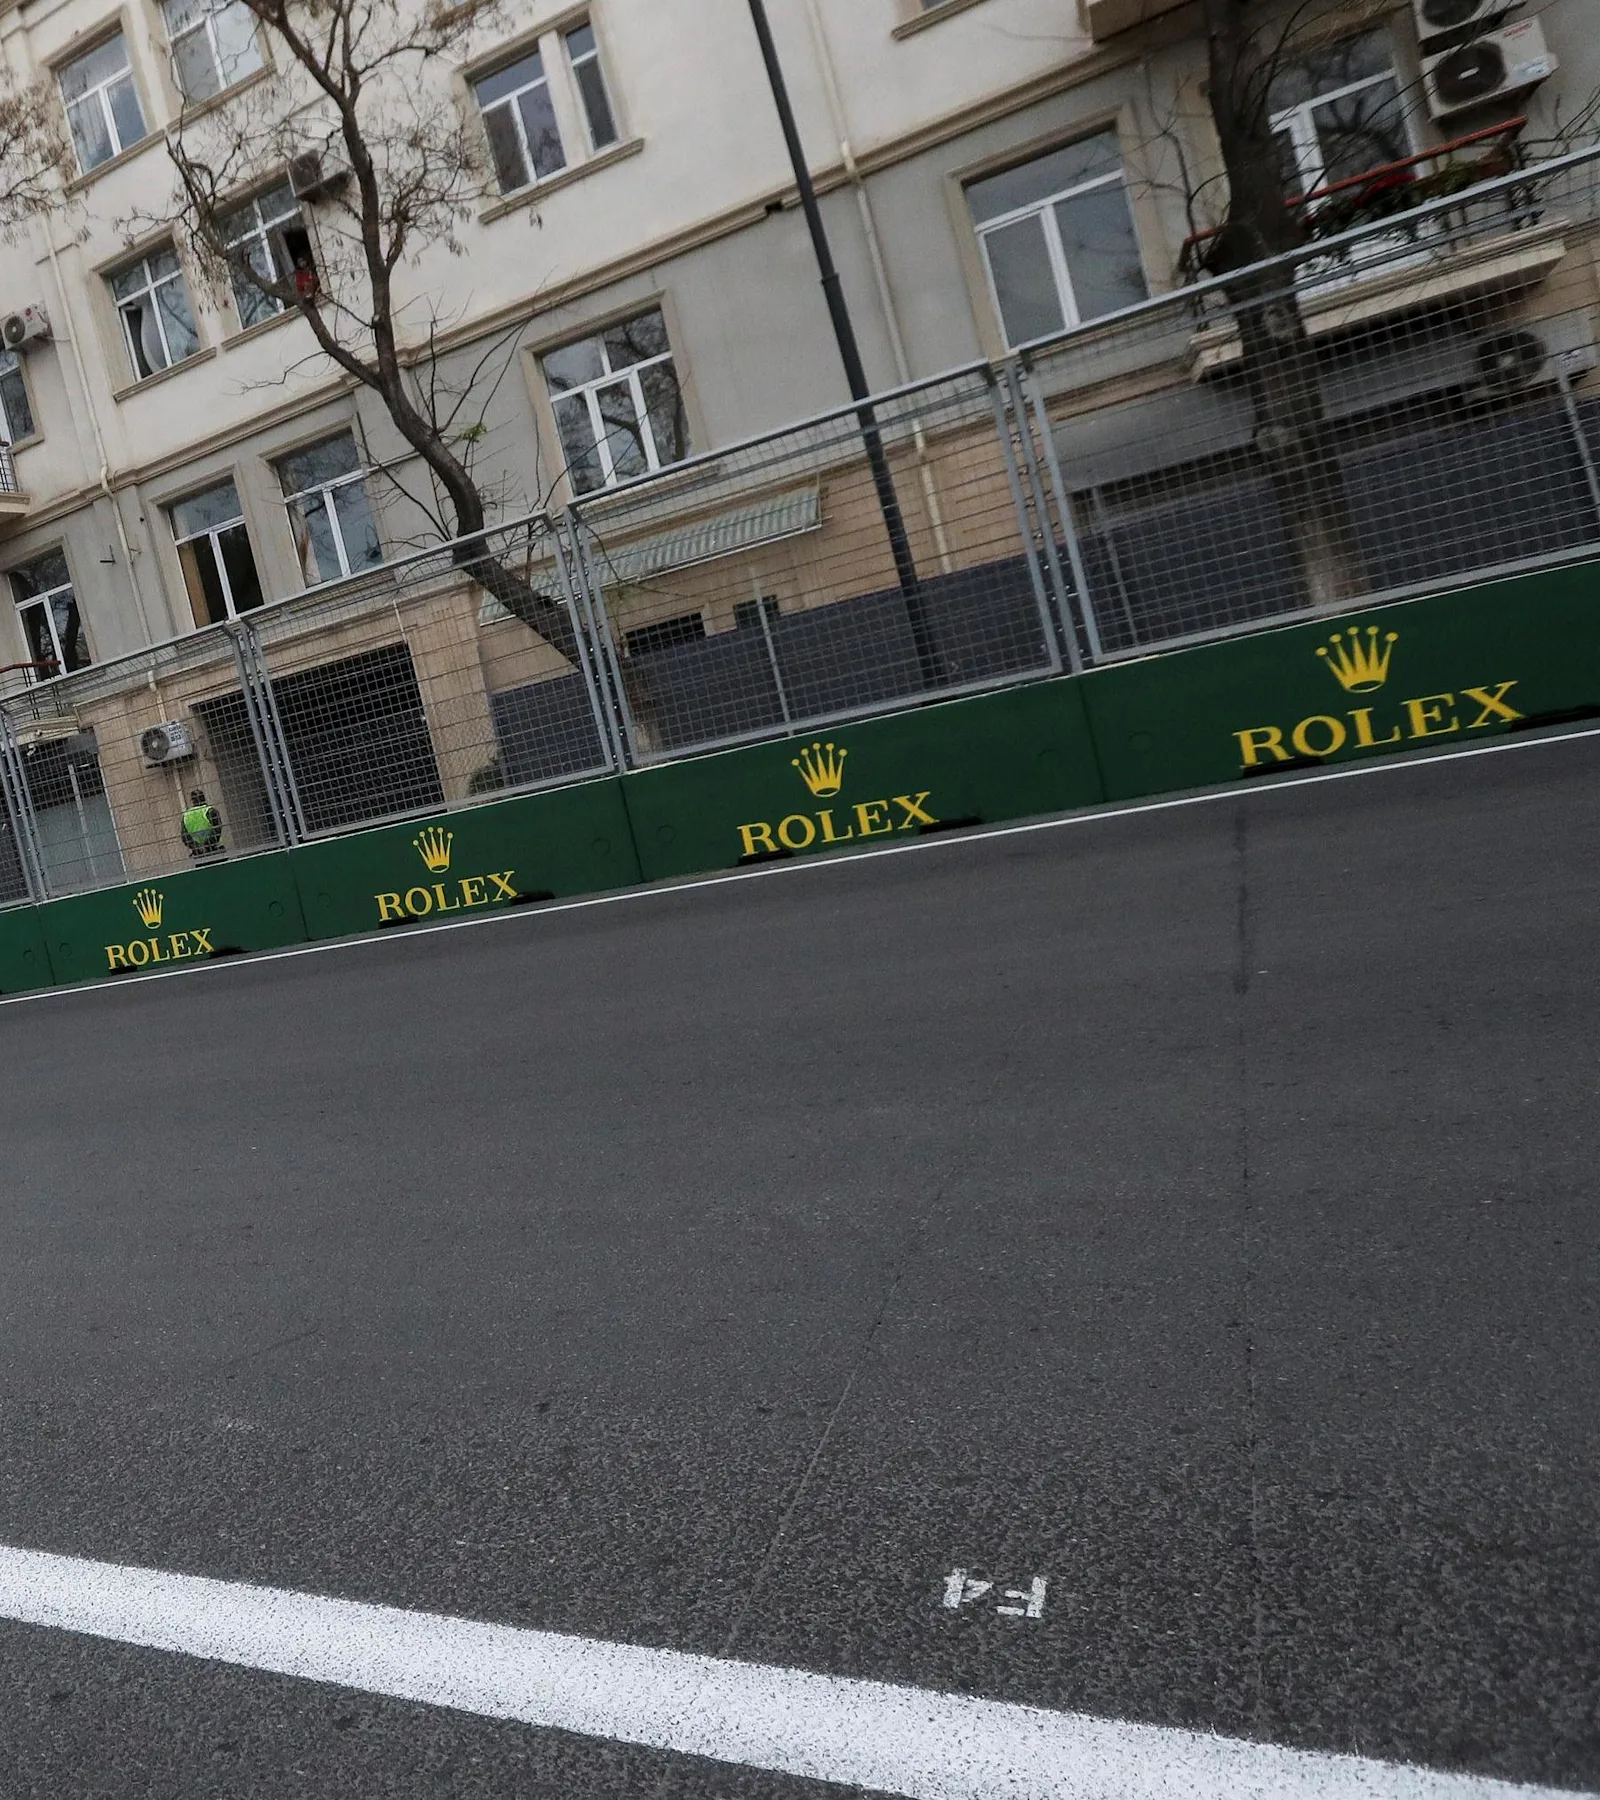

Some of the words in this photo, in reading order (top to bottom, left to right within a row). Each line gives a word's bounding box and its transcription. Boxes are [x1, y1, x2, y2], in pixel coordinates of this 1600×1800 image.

[1232, 680, 1527, 769] ROLEX
[737, 790, 939, 858] ROLEX
[374, 870, 520, 922] ROLEX
[105, 927, 216, 971] ROLEX
